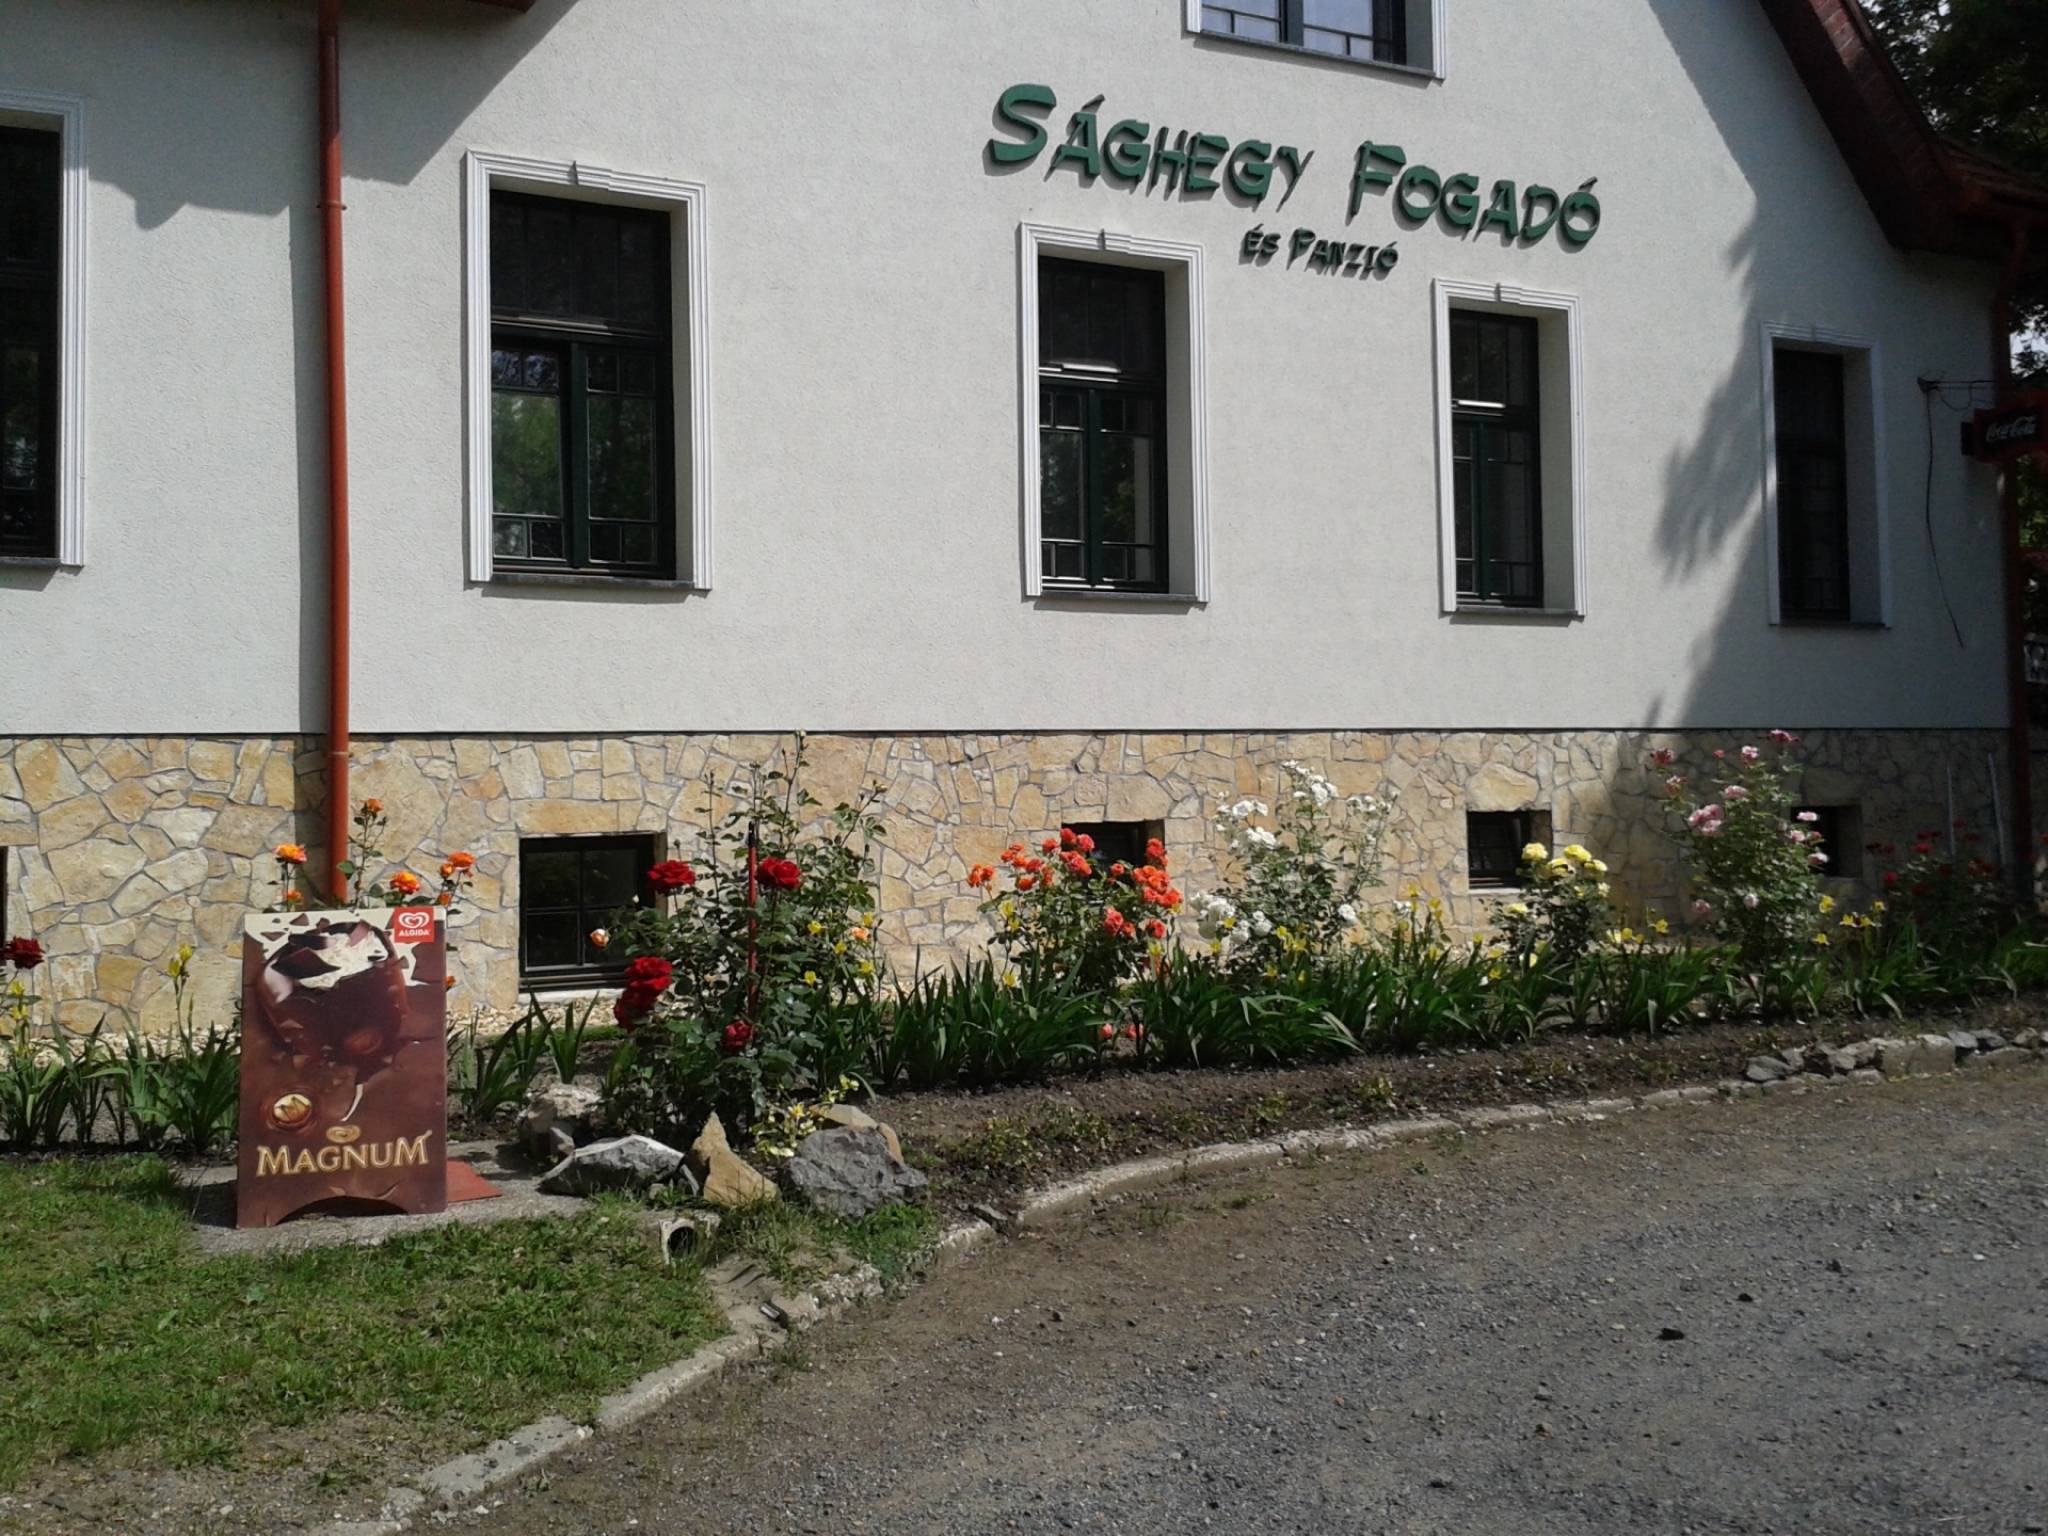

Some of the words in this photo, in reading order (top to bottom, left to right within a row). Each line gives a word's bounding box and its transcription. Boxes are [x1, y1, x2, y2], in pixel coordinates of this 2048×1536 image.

[986, 83, 1314, 210] SÁGHEGY
[1347, 140, 1601, 245] FOGADÓ
[398, 928, 430, 937] ALGIDA
[255, 1130, 433, 1178] MAGNUM
